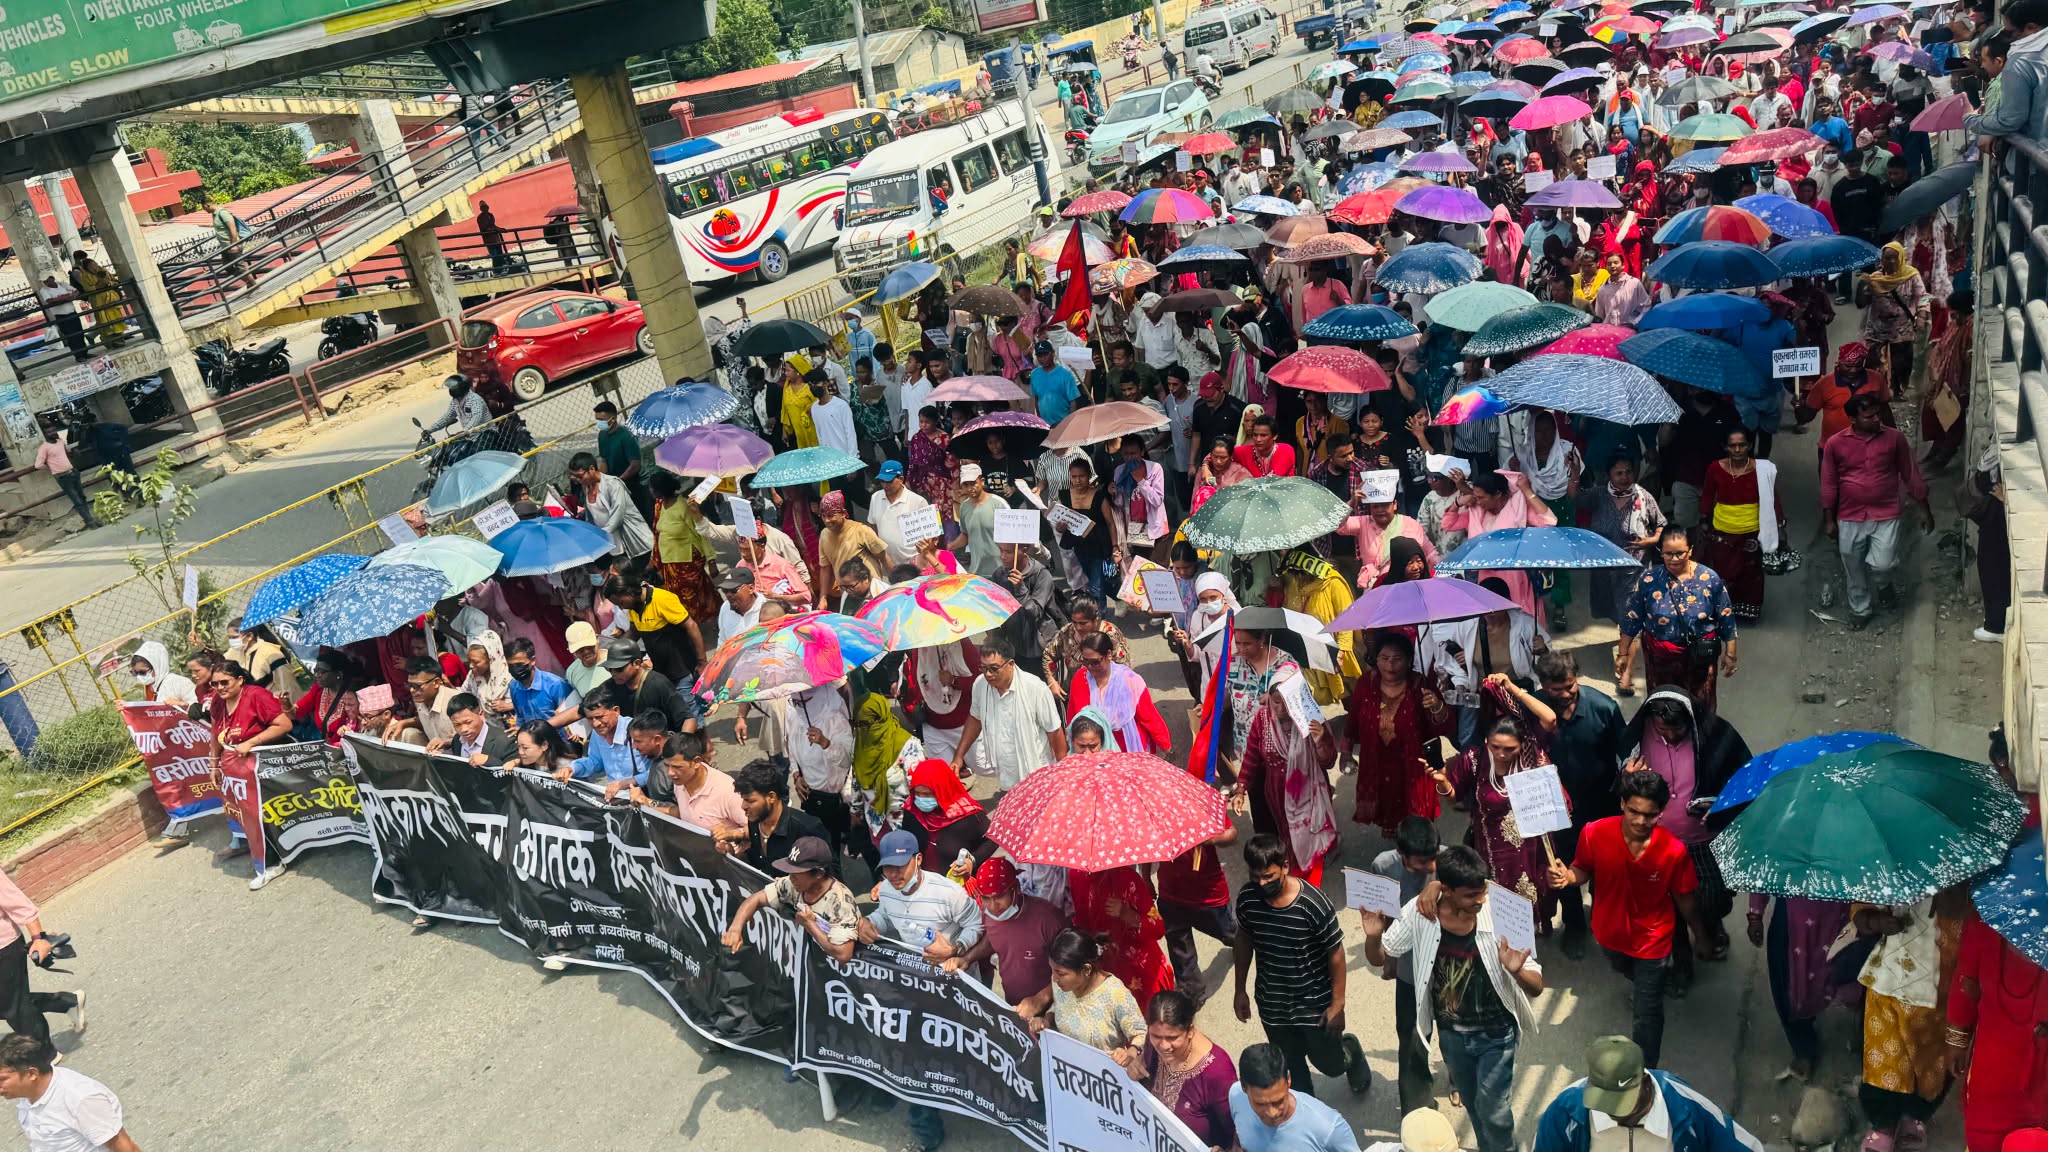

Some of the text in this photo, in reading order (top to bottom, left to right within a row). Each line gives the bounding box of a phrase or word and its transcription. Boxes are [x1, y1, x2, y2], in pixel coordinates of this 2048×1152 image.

[134, 8, 176, 31] FOUR
[4, 48, 129, 94] DRIVE SLOW
[879, 174, 911, 187] Travels
[825, 980, 1039, 1103] विरोध कार्यक्रम
[1052, 1055, 1125, 1117] सत्यवति
[1097, 1115, 1134, 1141] बुटवल
